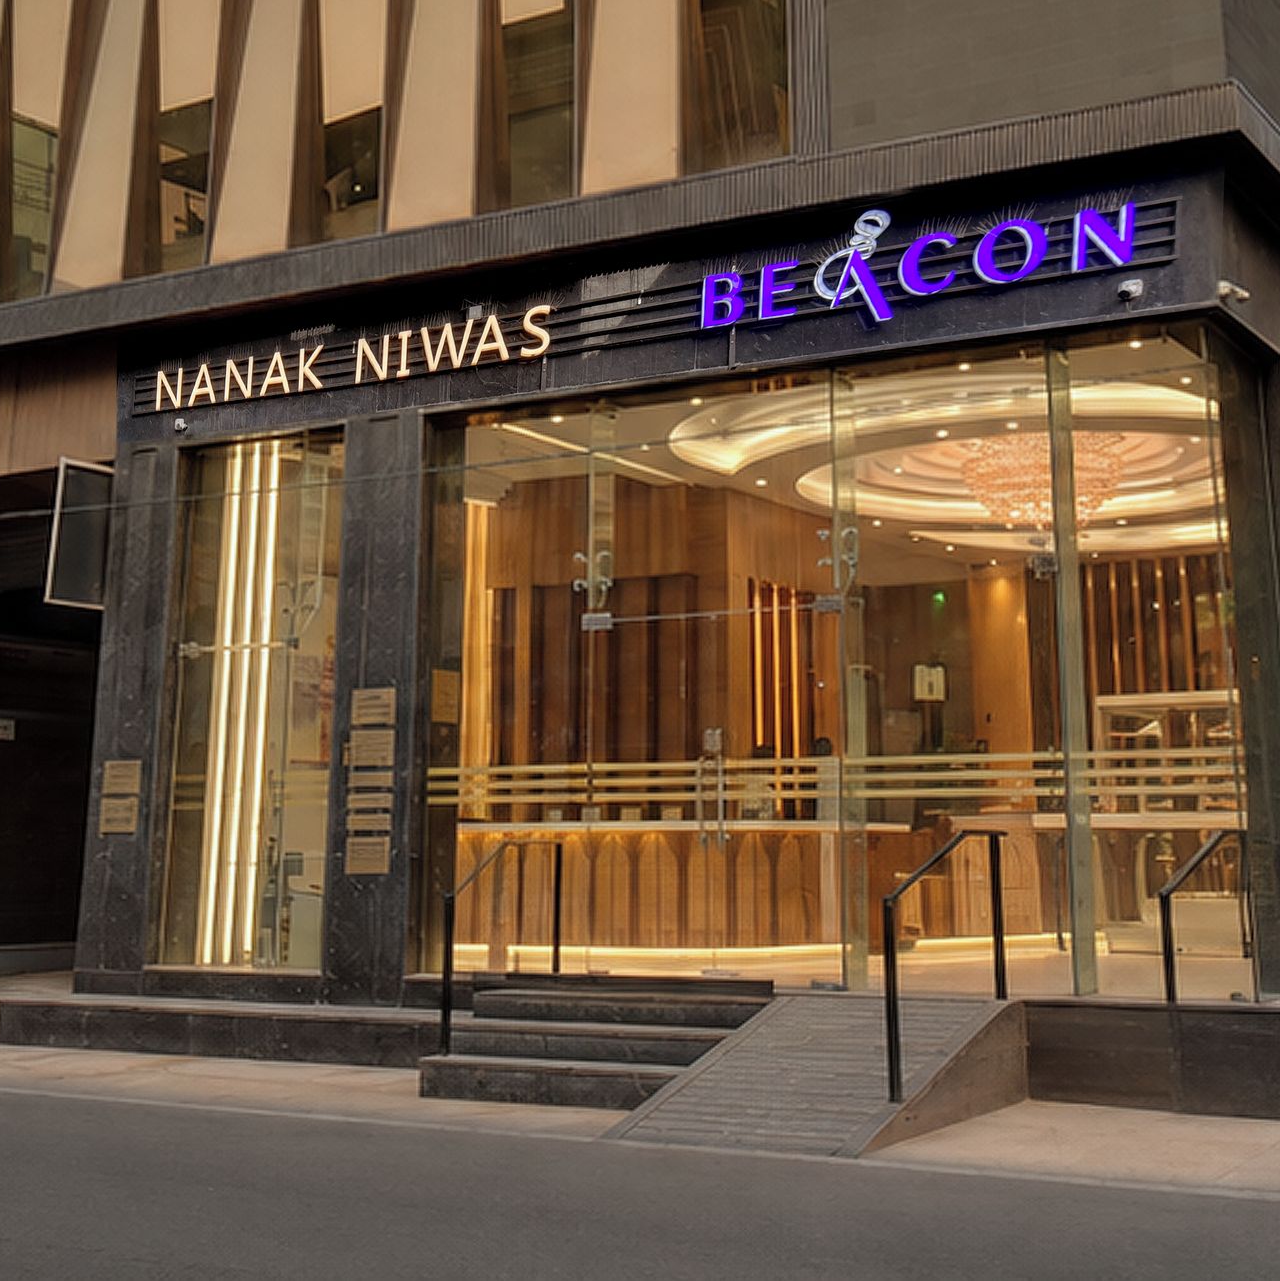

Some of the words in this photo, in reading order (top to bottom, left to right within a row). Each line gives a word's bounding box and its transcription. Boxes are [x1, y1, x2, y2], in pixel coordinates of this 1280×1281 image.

[699, 202, 1137, 329] BEACON
[155, 343, 324, 412] NANAK
[354, 304, 552, 385] NIWAS
